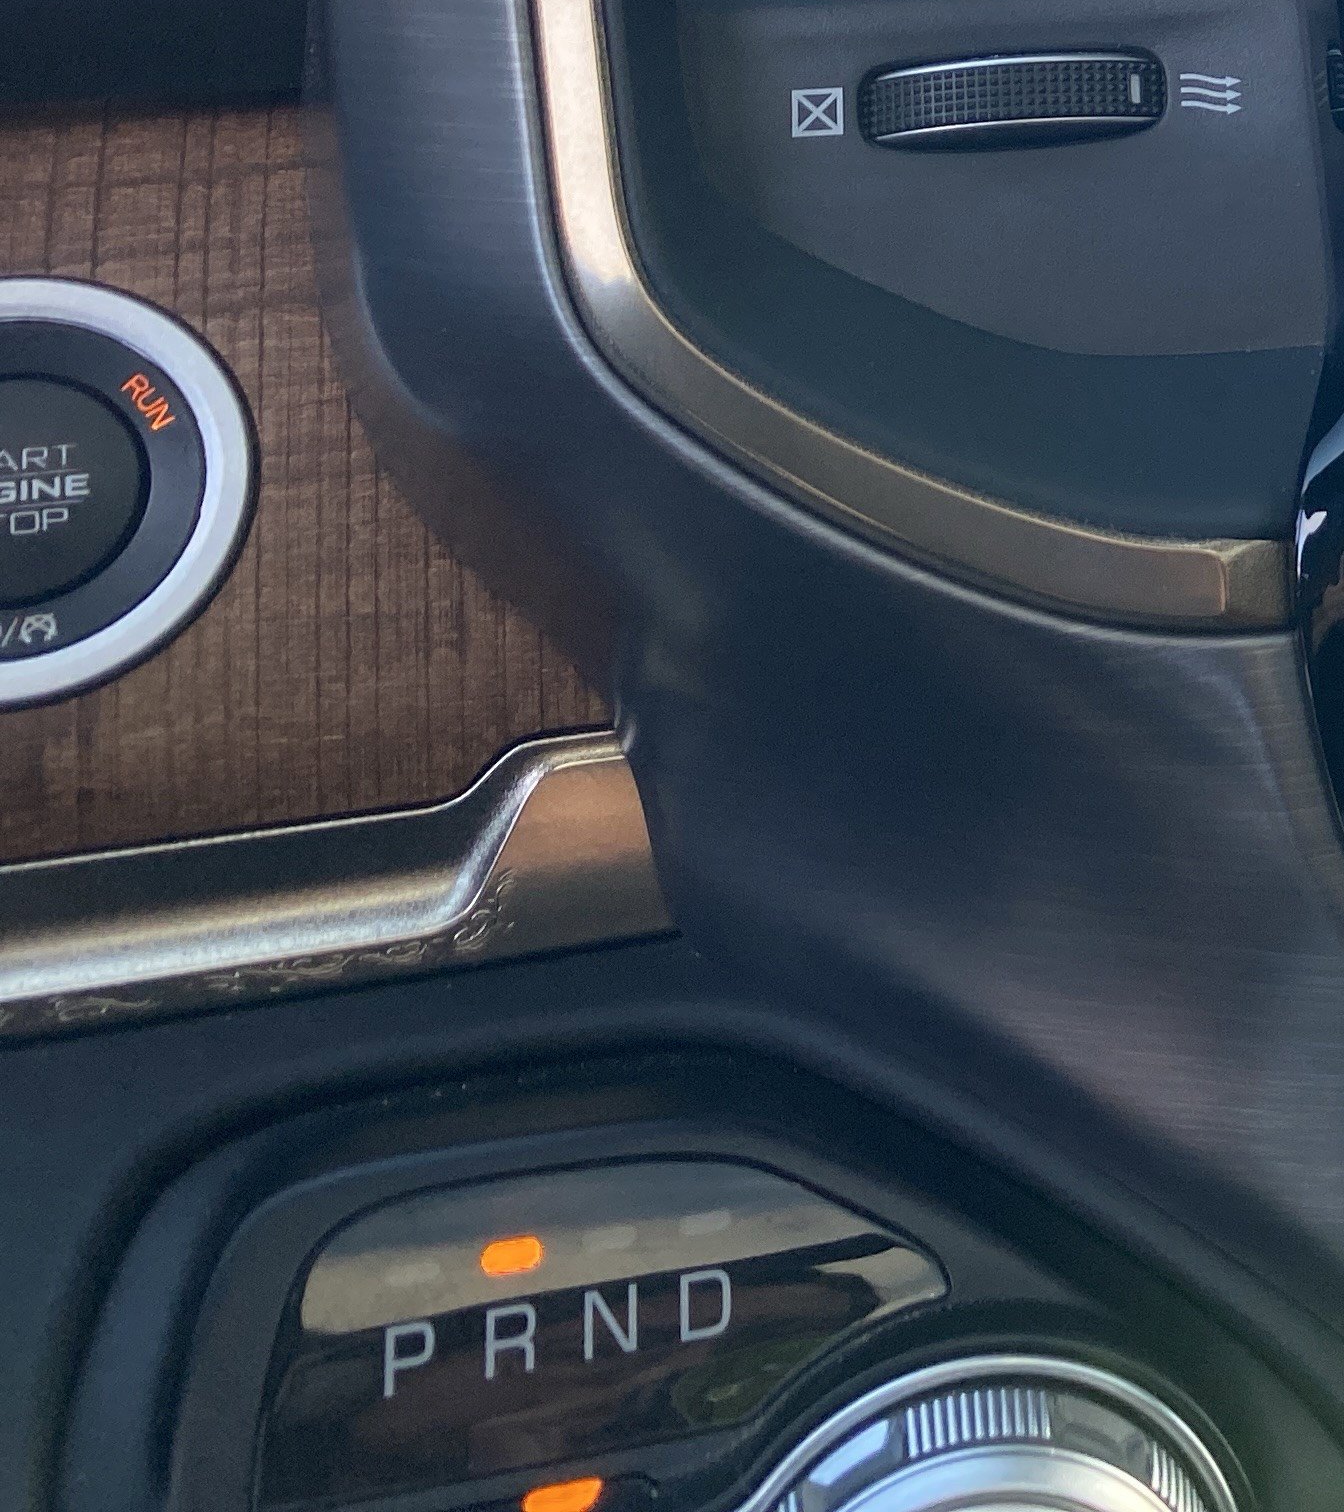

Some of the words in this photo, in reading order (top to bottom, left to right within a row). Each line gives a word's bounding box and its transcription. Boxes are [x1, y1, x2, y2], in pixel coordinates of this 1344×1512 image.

[121, 372, 176, 432] RUN
[382, 1321, 435, 1398] P
[485, 1303, 537, 1381] R
[583, 1283, 637, 1361] N
[679, 1268, 733, 1344] D
